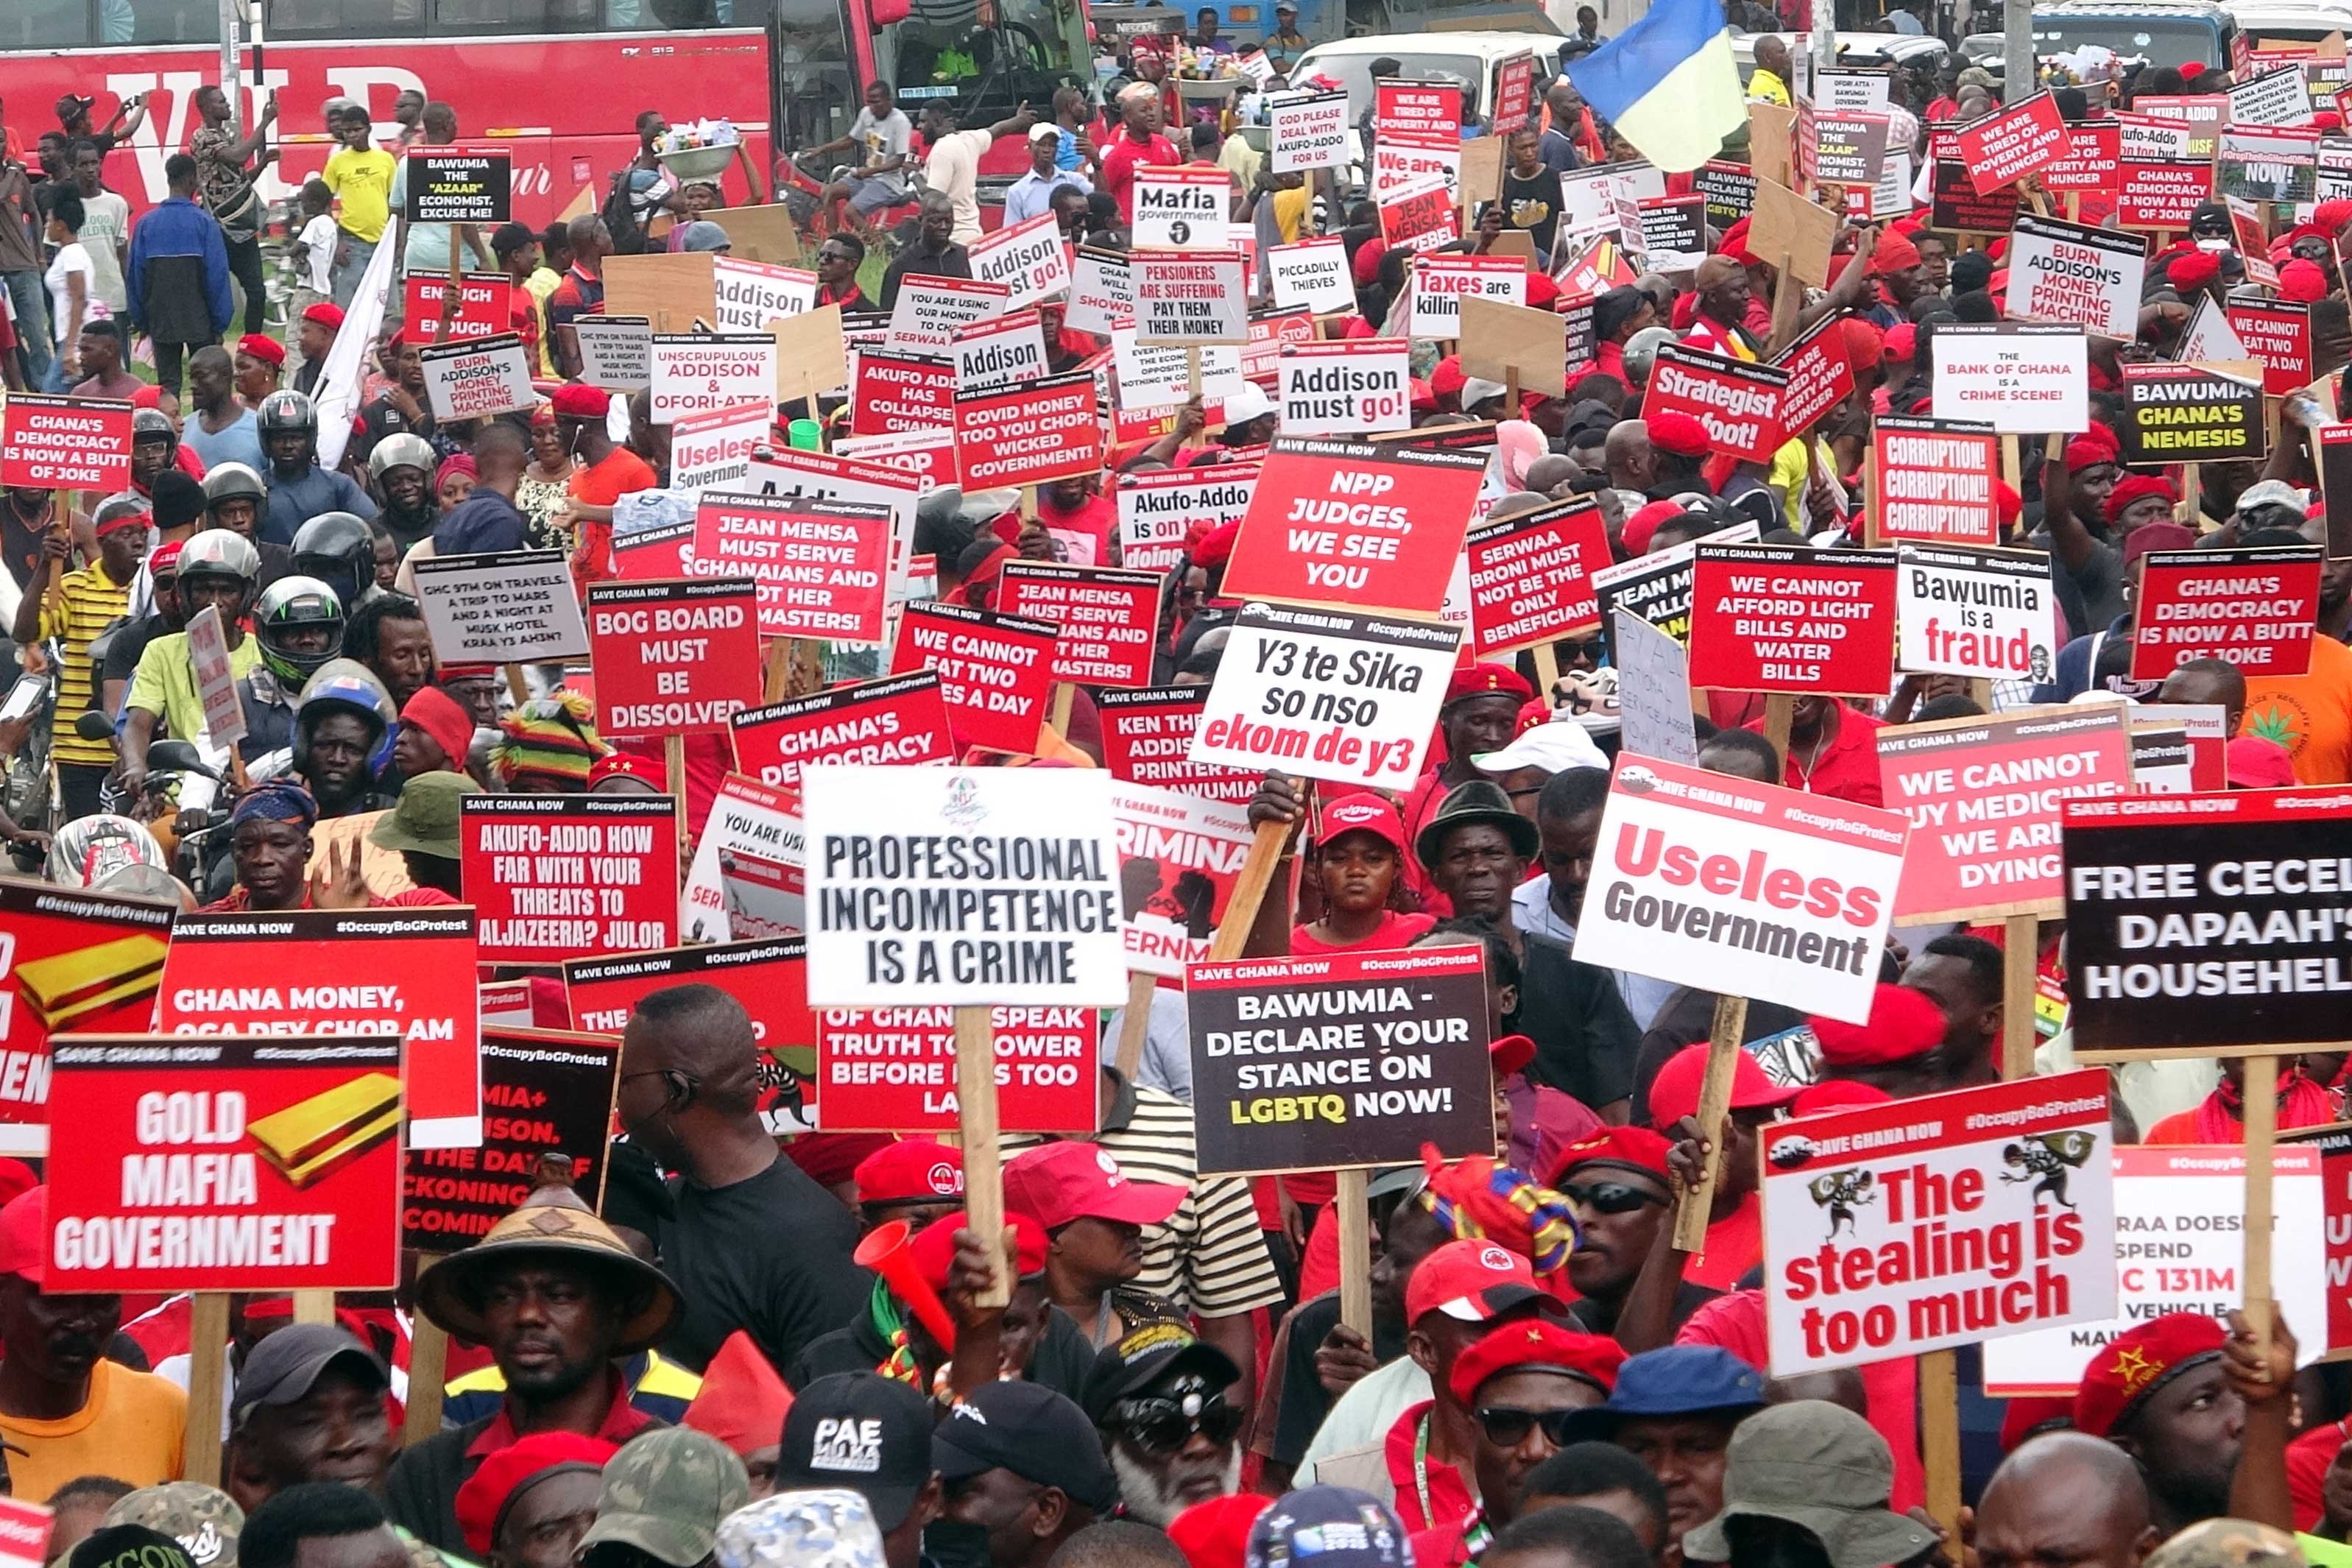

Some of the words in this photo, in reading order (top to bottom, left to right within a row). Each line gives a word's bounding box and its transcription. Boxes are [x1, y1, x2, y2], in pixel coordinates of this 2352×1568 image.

[1279, 114, 1301, 125] GOD
[1303, 108, 1341, 122] PLEASE
[1980, 126, 2004, 142] WE
[2005, 113, 2031, 133] ARE
[1281, 127, 1307, 138] DEAL
[1310, 123, 1336, 134] WITH
[1982, 135, 2019, 156] TIRED
[2021, 124, 2039, 141] OF
[1276, 135, 1343, 152] AKUFO-ADDO
[1972, 146, 2029, 175] POVERTY
[2029, 129, 2060, 150] AND
[428, 159, 489, 169] BAWUMIA
[1293, 153, 1312, 164] FOR
[1315, 150, 1327, 160] US
[1996, 149, 2049, 177] HUNGER
[429, 183, 483, 193] "AZAAR"
[444, 171, 468, 181] THE
[419, 196, 493, 205] ECONOMIST.
[1142, 186, 1215, 209] Mafia
[420, 208, 467, 218] EXCUSE
[470, 208, 492, 218] ME!
[1137, 211, 1217, 221] government
[2052, 244, 2100, 265] BURN
[1146, 266, 1215, 280] PENSIONERS
[1279, 261, 1338, 277] PICCADILLY
[2028, 255, 2122, 283] ADDISON'S
[1140, 284, 1162, 298] ARE
[1165, 283, 1225, 298] SUFFERING
[1290, 277, 1335, 291] THIEVES
[1418, 271, 1482, 294] Taxes
[1486, 282, 1511, 294] are
[2042, 274, 2105, 295] MONEY
[1154, 302, 1174, 317] PAY
[1178, 302, 1211, 317] THEM
[2032, 287, 2111, 313] PRINTING
[1147, 320, 1179, 334] THEIR
[1183, 320, 1223, 334] MONEY
[2031, 303, 2108, 327] MACHINE
[658, 352, 766, 361] UNSCRUPULOUS
[668, 364, 759, 377] ADDISON
[1947, 364, 1989, 374] BANK
[1993, 364, 2013, 374] OF
[2018, 364, 2072, 374] GHANA
[707, 379, 720, 392] &
[1657, 367, 1779, 419] Strategist
[1999, 378, 2009, 386] IS
[2133, 383, 2253, 401] BAWUMIA
[1960, 390, 2006, 400] CRIME
[2010, 390, 2062, 400] SCENE!
[965, 406, 1020, 425] COVID
[1023, 395, 1084, 420] MONEY
[2138, 405, 2243, 425] GHANA'S
[29, 415, 103, 432] GHANA'S
[959, 427, 997, 444] TOO
[1000, 420, 1036, 437] YOU
[15, 431, 121, 450] DEMOCRACY
[993, 434, 1063, 456] WICKED
[2143, 428, 2246, 448] NEMESIS
[4, 447, 20, 459] IS
[23, 448, 66, 462] NOW
[69, 451, 82, 464] A
[85, 453, 130, 467] BUTT
[970, 445, 1092, 477] GOVERNMENT!
[1887, 437, 1986, 470] CORRUPTION!
[30, 465, 54, 478] OF
[56, 467, 100, 482] JOKE
[1329, 471, 1394, 496] NPP
[1886, 469, 1988, 503] CORRUPTION!!
[1288, 498, 1412, 534] JUDGES,
[1887, 502, 1988, 536] CORRUPTION!!
[1289, 529, 1338, 554] WE
[1341, 534, 1400, 560] SEE
[1481, 530, 1560, 565] SERWAA
[1307, 562, 1369, 589] YOU
[1471, 559, 1528, 588] BRONI
[1530, 545, 1581, 571] MUST
[1477, 582, 1515, 606] NOT
[1520, 577, 1543, 593] BE
[1545, 563, 1583, 585] THE
[1730, 576, 1767, 593] WE
[1772, 578, 1863, 597] CANNOT
[1913, 569, 2038, 611] Bawumia
[2178, 576, 2280, 596] GHANA'S
[1511, 590, 1558, 617] ONLY
[1717, 597, 1805, 616] AFFORD
[1810, 601, 1874, 618] LIGHT
[2155, 599, 2303, 620] DEMOCRACY
[596, 611, 648, 635] BOG
[655, 605, 744, 632] BOARD
[1483, 599, 1598, 644] BENEFICIARY
[1735, 620, 1790, 637] BILLS
[1798, 622, 1846, 639] AND
[1961, 607, 1978, 626] is
[1983, 612, 1993, 629] a
[1927, 620, 2028, 670] fraud
[2139, 626, 2161, 644] IS
[2165, 626, 2224, 642] NOW
[2230, 624, 2248, 641] A
[2253, 622, 2315, 640] BUTT
[641, 638, 708, 664] MUST
[1754, 642, 1831, 660] WATER
[2177, 649, 2203, 664] OF
[2214, 647, 2272, 664] JOKE
[1256, 638, 1298, 676] Y3
[1304, 644, 1335, 681] te
[1343, 650, 1422, 693] Sika
[1762, 663, 1820, 681] BILLS
[657, 671, 690, 694] BE
[1262, 687, 1306, 717] so
[1313, 692, 1377, 726] nso
[1204, 713, 1310, 758] ekom
[1314, 722, 1361, 763] de
[1369, 736, 1414, 777] y3
[480, 824, 601, 852] AKUFO-ADDO
[607, 825, 652, 853] HOW
[494, 856, 530, 883] FAR
[535, 857, 585, 883] WITH
[590, 857, 640, 885] YOUR
[826, 836, 1107, 881] PROFESSIONAL
[1614, 822, 1883, 929] Useless
[511, 888, 595, 916] THREATS
[599, 889, 624, 917] TO
[821, 887, 1117, 933] INCOMPETENCE
[479, 919, 598, 947] ALJAZEERA?
[603, 920, 665, 949] JULOR
[1605, 877, 1870, 979] Government
[868, 940, 905, 983] IS
[915, 939, 945, 983] A
[952, 940, 1076, 983] CRIME
[1238, 987, 1413, 1020] BAWUMIA
[1207, 1024, 1365, 1056] DECLARE
[1372, 1017, 1469, 1049] YOUR
[1238, 1059, 1371, 1090] STANCE
[1380, 1054, 1431, 1081] ON
[1231, 1095, 1346, 1124] LGBTQ
[1355, 1087, 1452, 1117] NOW!
[137, 1091, 246, 1145] GOLD
[122, 1154, 257, 1207] MAFIA
[1878, 1164, 1983, 1223] The
[54, 1214, 336, 1270] GOVERNMENT
[1784, 1220, 2024, 1304] stealing
[2035, 1206, 2085, 1262] is
[1802, 1306, 1901, 1360] too
[1908, 1264, 2069, 1341] much
[816, 1419, 882, 1443] PAE
